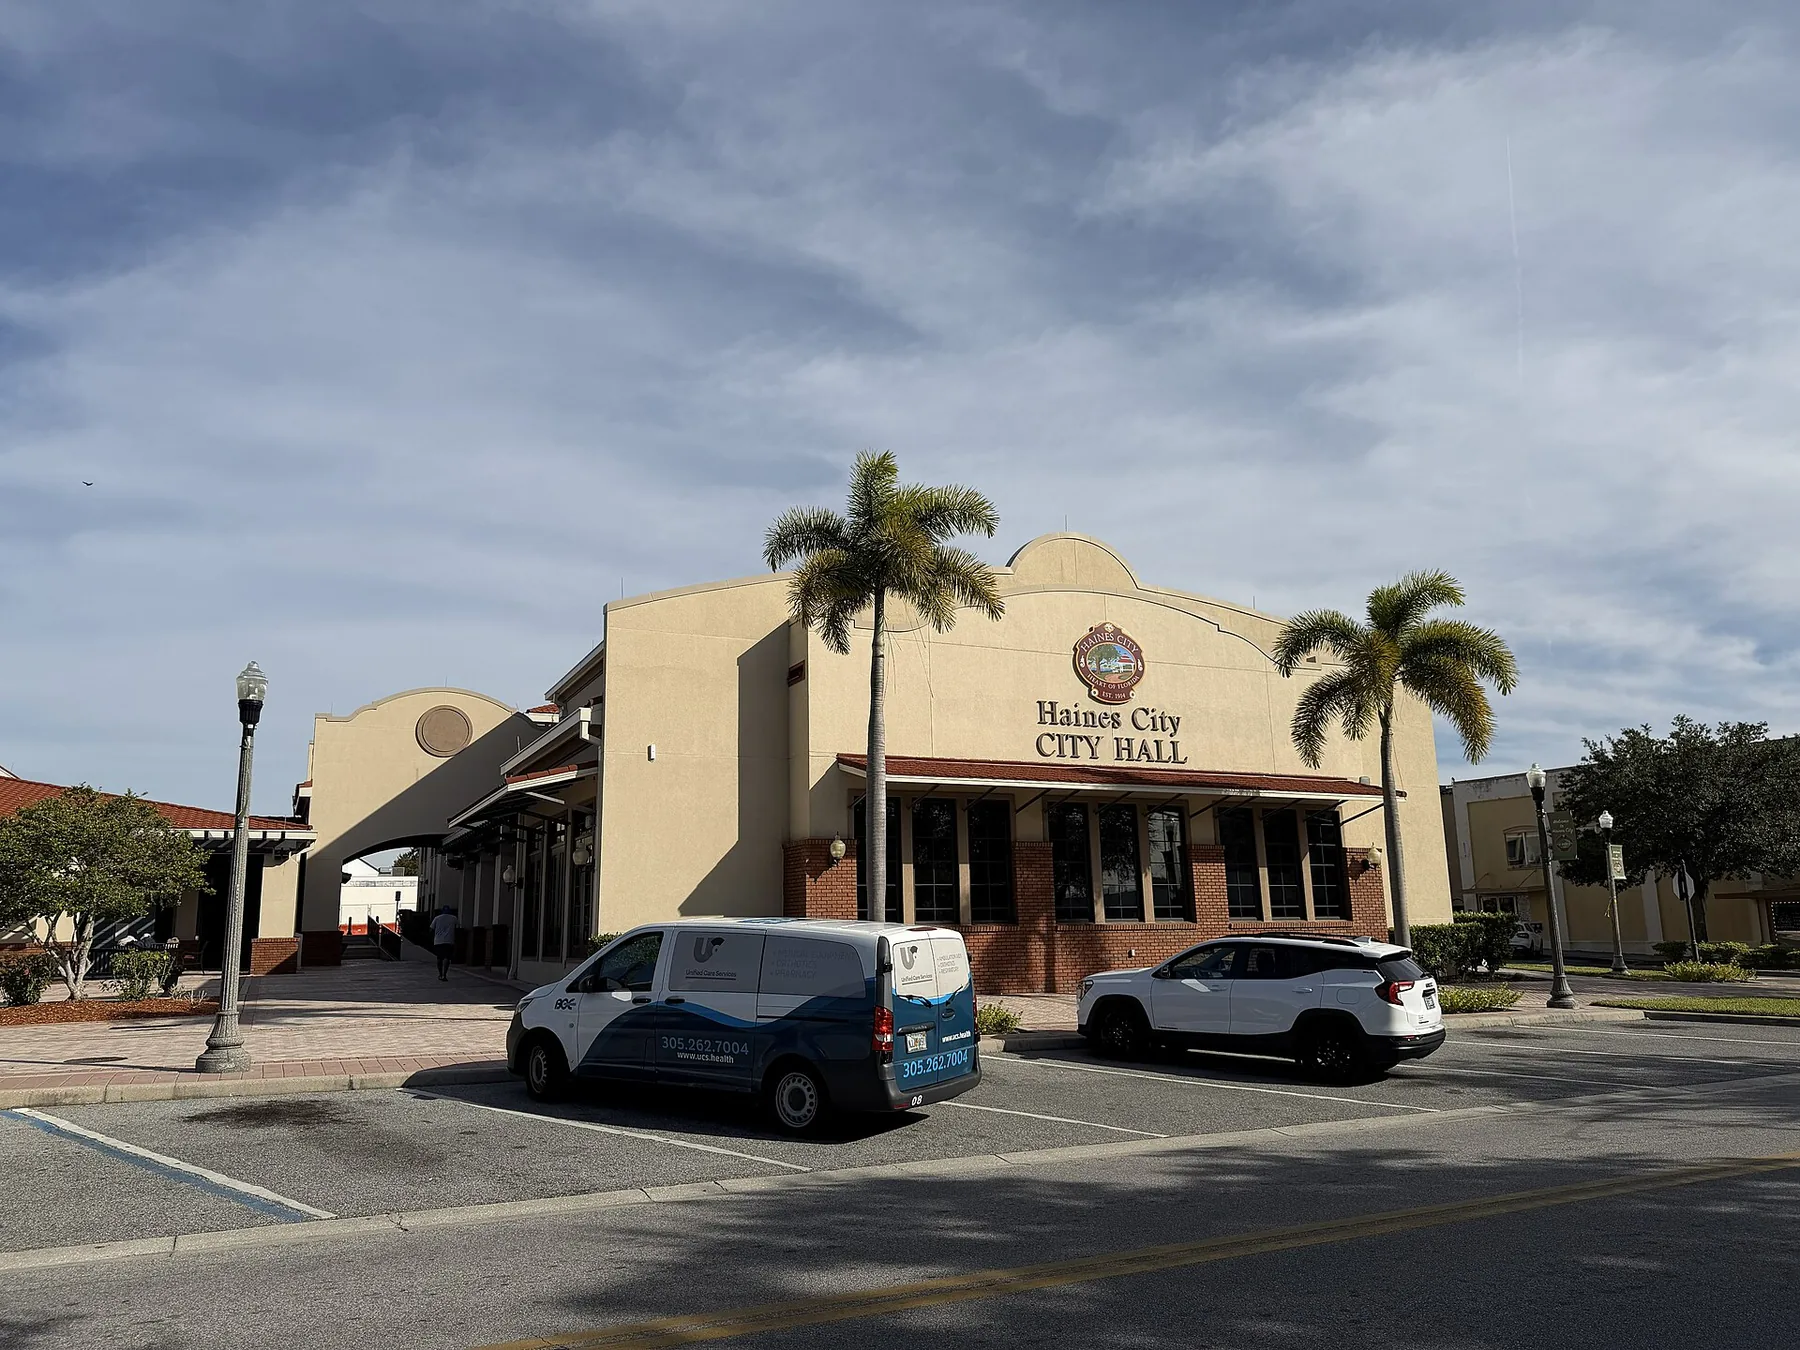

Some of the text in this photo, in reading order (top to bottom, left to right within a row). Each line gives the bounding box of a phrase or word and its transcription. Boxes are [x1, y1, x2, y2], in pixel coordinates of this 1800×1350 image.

[1081, 633, 1139, 653] HAINES CITY
[1118, 675, 1140, 689] FLORIDA
[1036, 700, 1182, 737] Haines City
[1035, 732, 1188, 765] CITY HALL
[661, 1036, 749, 1055] 305.262.7004
[676, 1051, 734, 1064] www.ucs.health
[903, 1049, 968, 1078] 305.262.7004
[911, 1094, 923, 1106] 08
